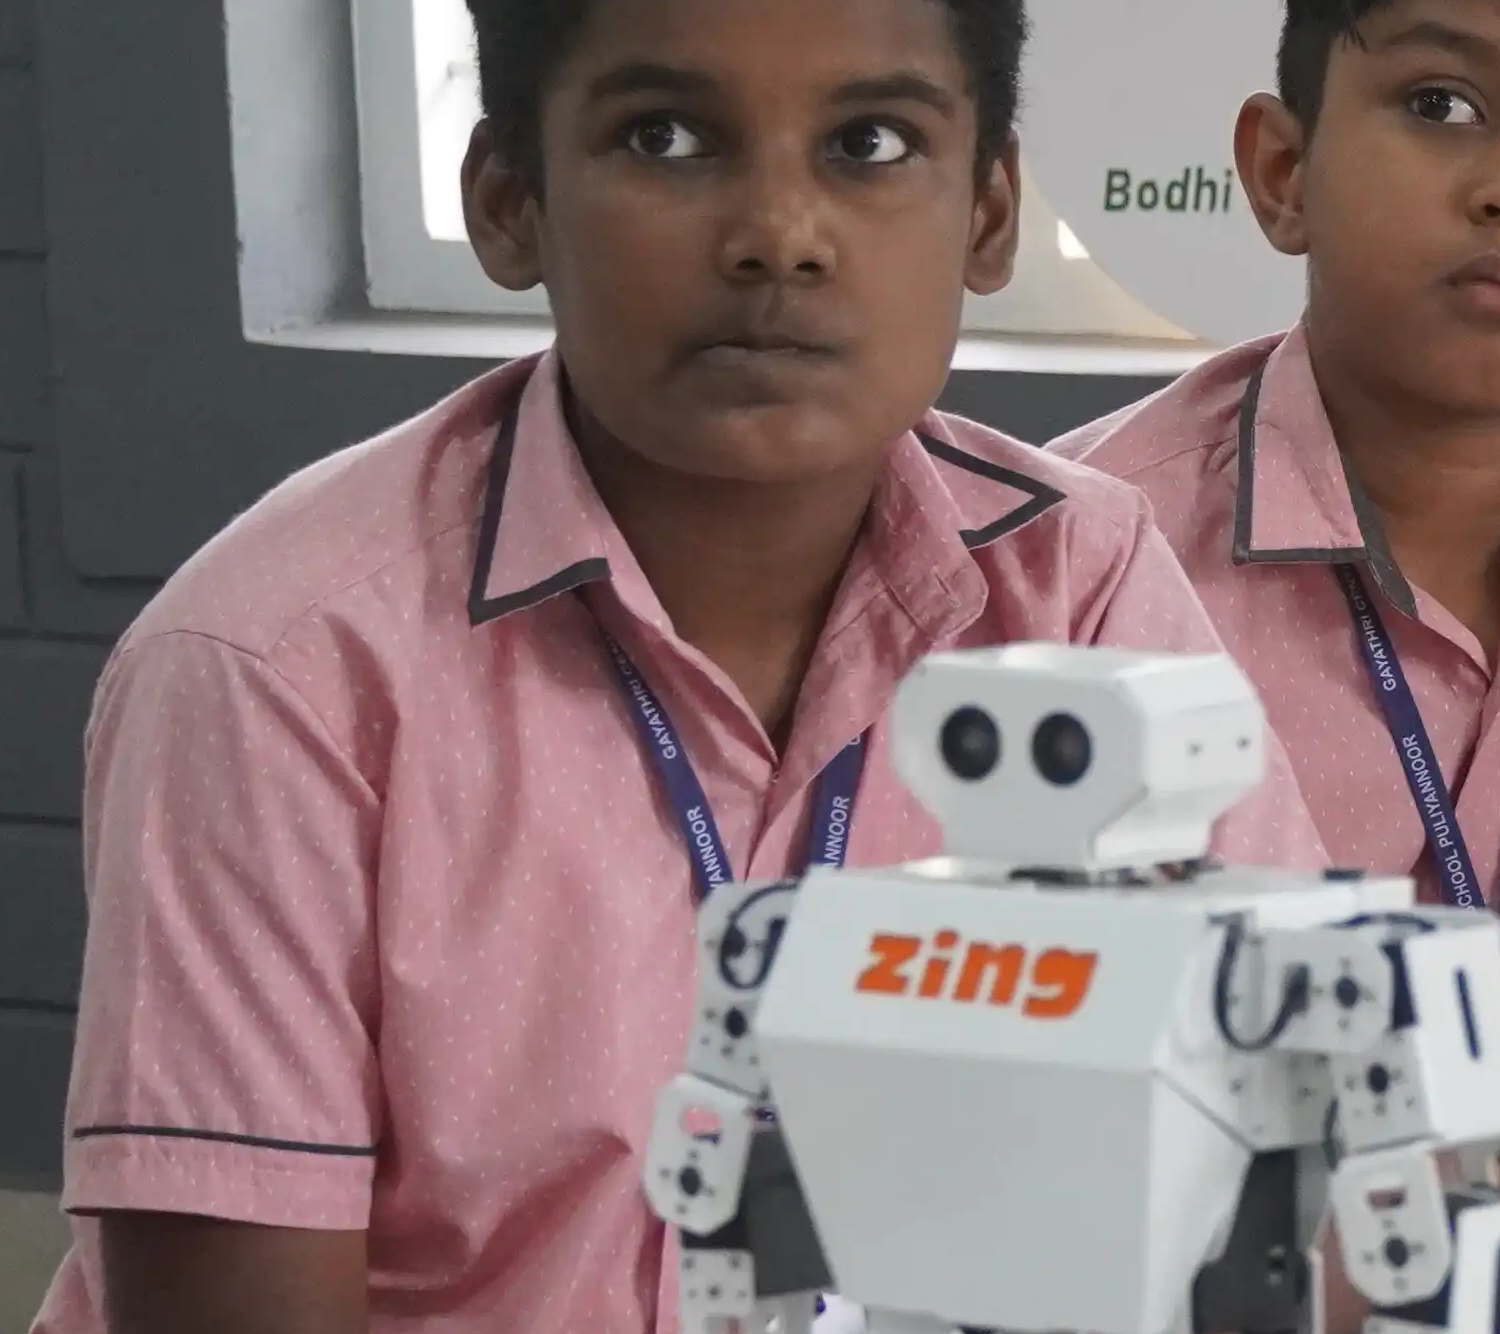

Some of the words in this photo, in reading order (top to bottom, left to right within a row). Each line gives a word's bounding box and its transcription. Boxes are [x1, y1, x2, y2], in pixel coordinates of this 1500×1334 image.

[1102, 167, 1232, 214] Bodhi
[1361, 612, 1397, 692] GAYATHRI
[1402, 734, 1454, 849] PULIYANNOOR
[856, 929, 1099, 1021] zing
